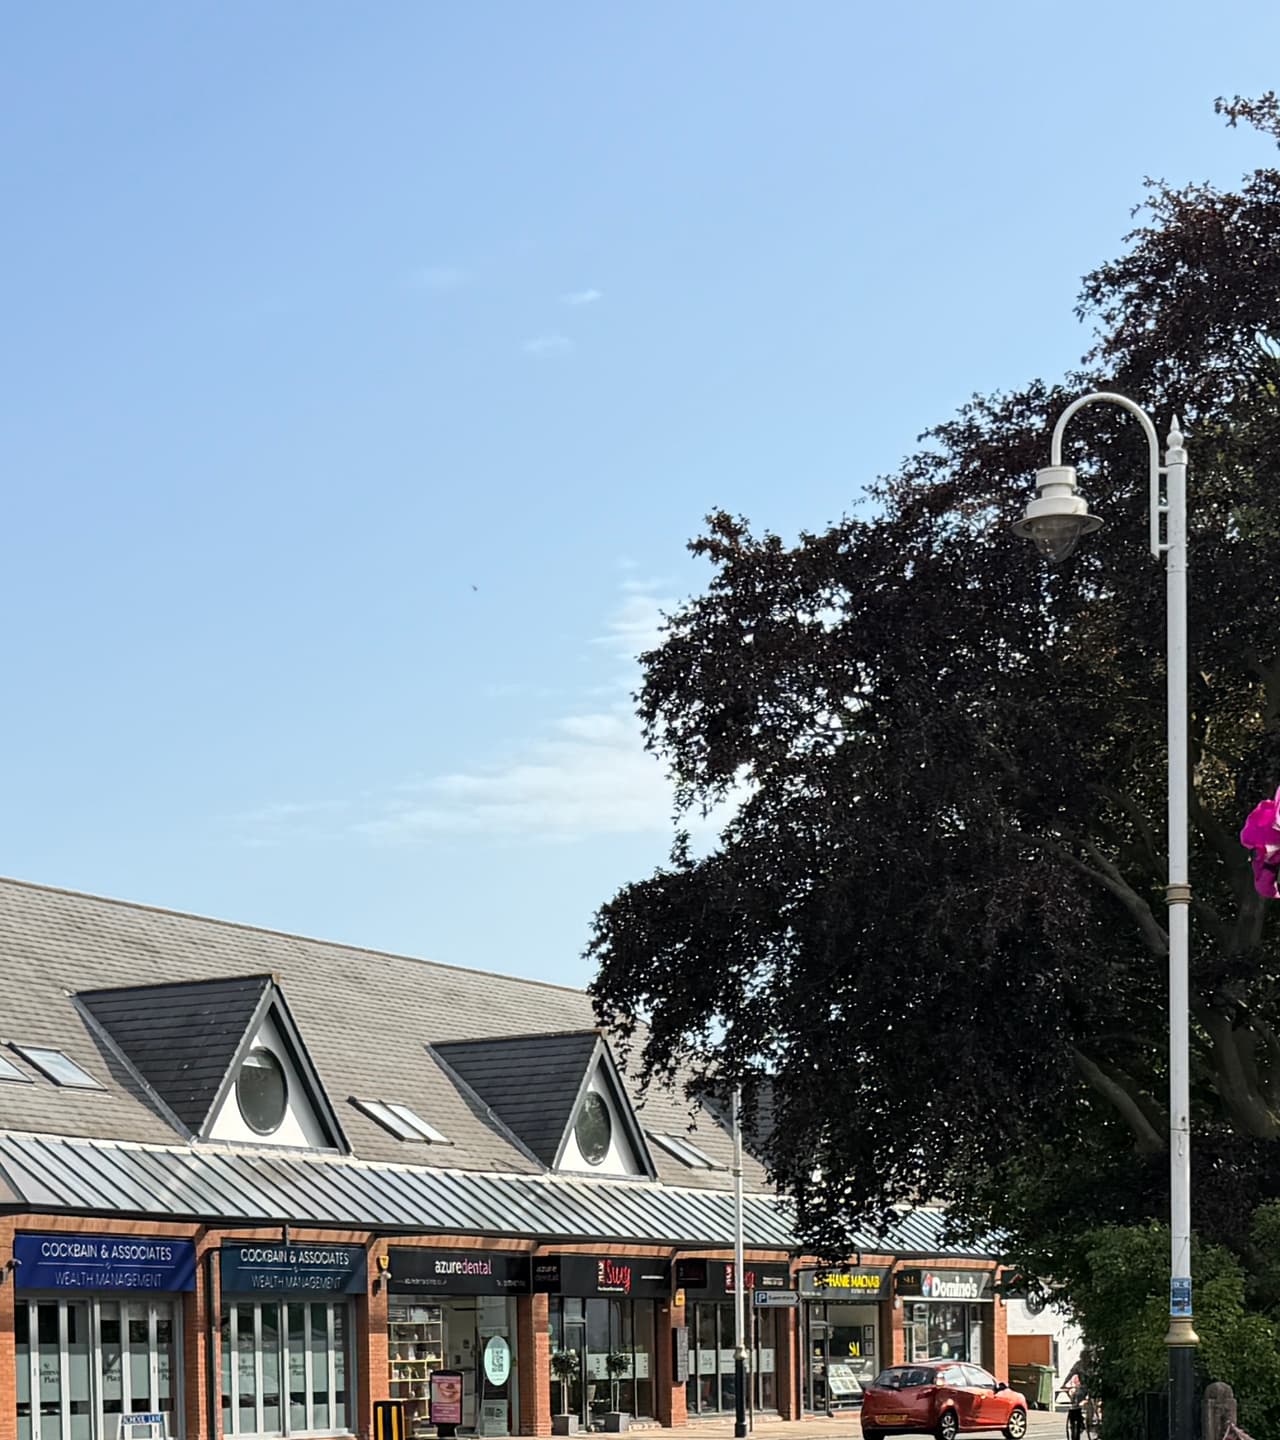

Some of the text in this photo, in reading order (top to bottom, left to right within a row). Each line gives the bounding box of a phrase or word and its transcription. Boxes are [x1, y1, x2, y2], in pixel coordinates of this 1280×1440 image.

[41, 1241, 172, 1261] COCKBAIN & ASSOCIATES
[240, 1248, 350, 1266] COCKBAIN & ASSOCIATES
[434, 1259, 492, 1276] azuredental
[55, 1271, 162, 1289] WEALTH MANAGEMENT
[251, 1274, 342, 1290] WEALTH MANAGEMENT
[932, 1276, 978, 1298] Domino's
